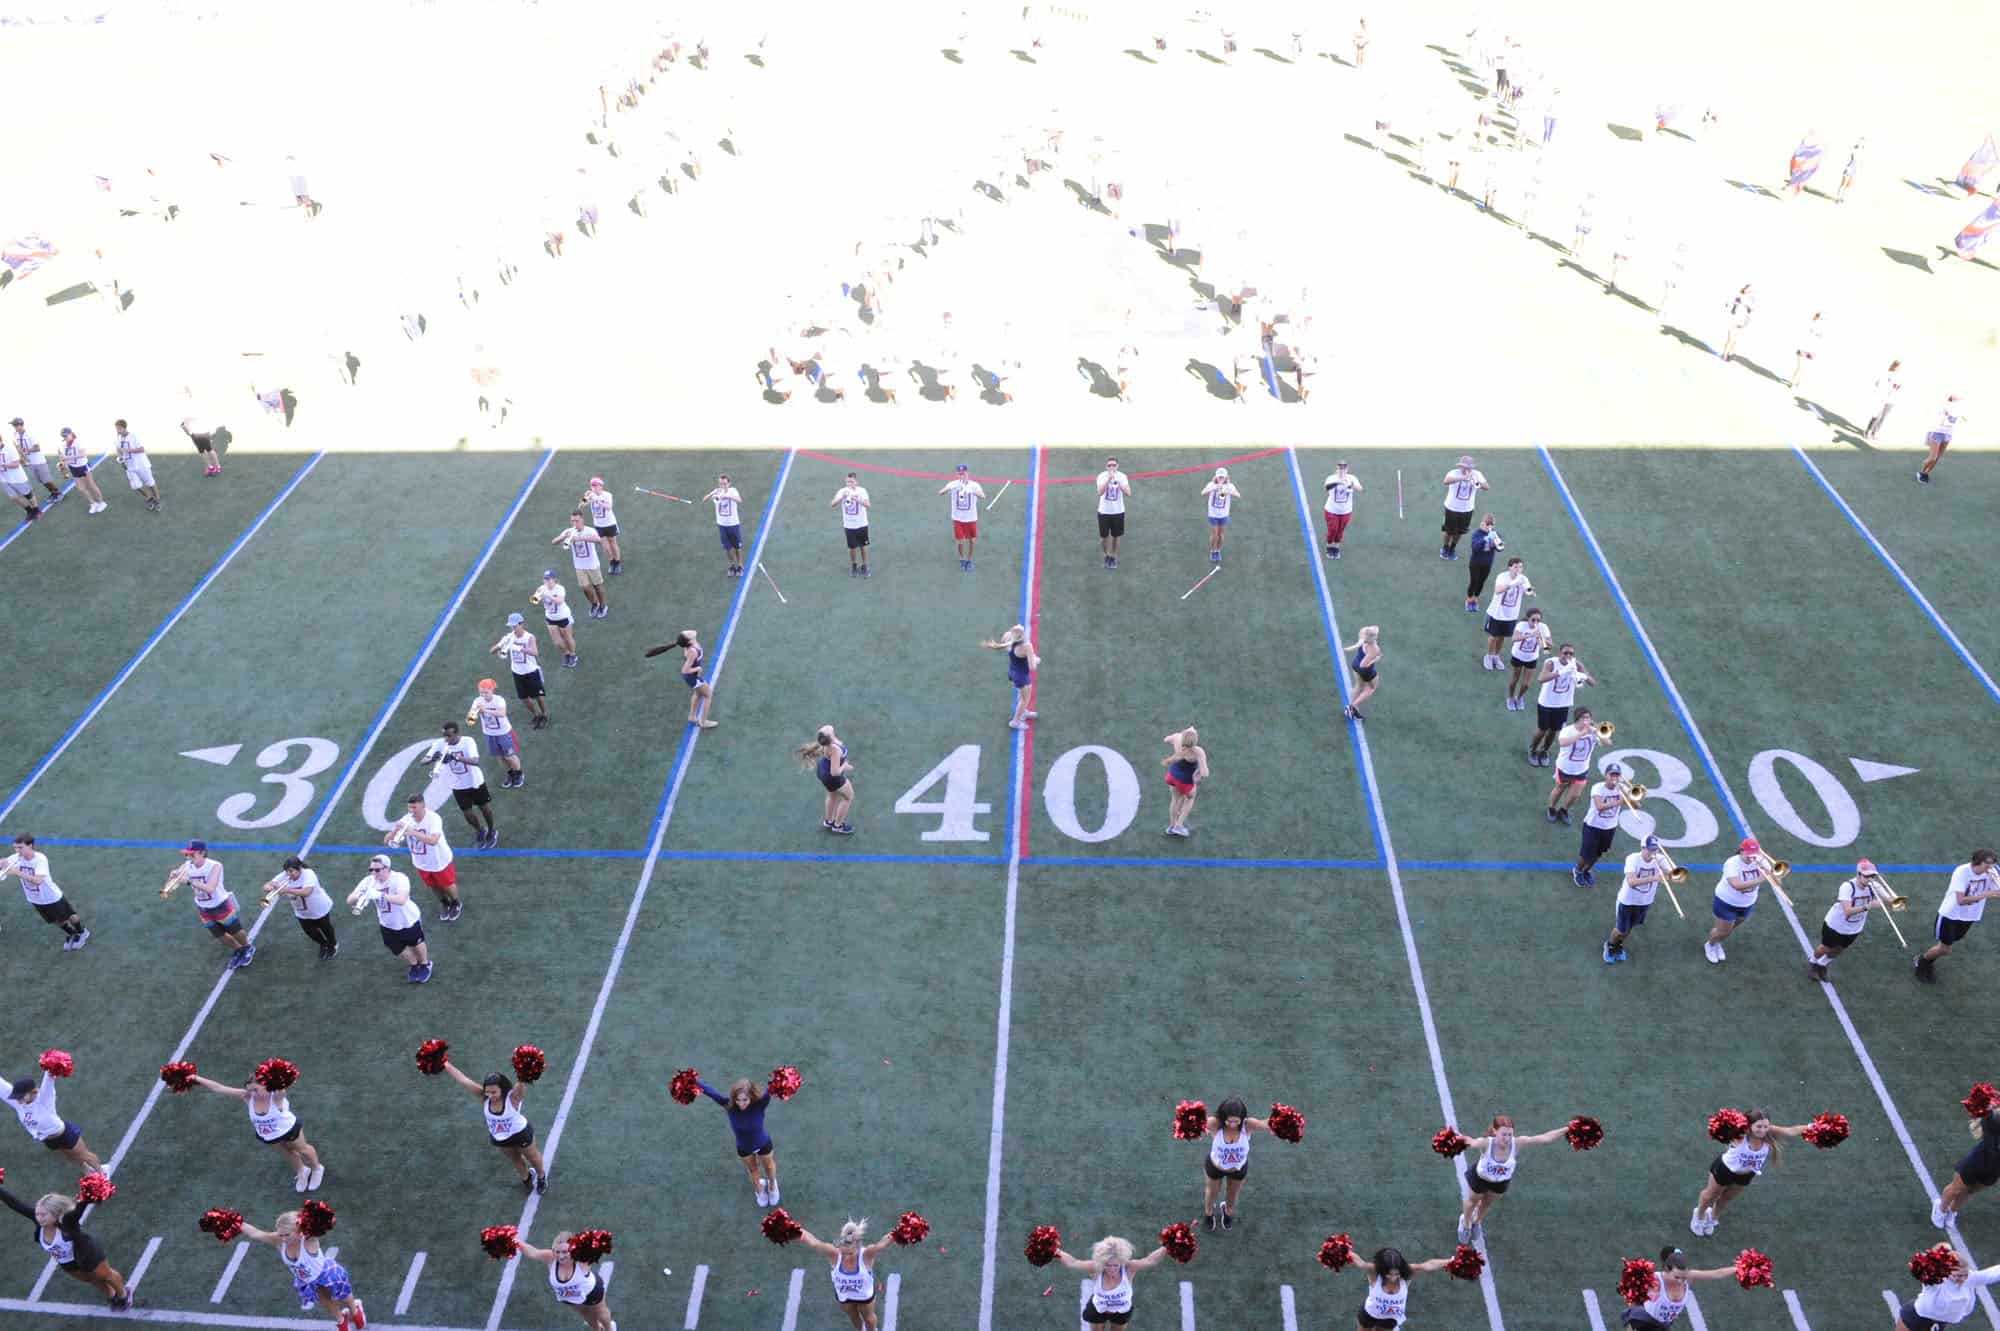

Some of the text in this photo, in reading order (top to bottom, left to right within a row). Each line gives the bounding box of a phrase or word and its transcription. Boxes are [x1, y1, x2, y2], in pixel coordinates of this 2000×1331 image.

[216, 737, 455, 831] 30
[894, 744, 1142, 842] 40
[1597, 748, 1862, 848] 30
